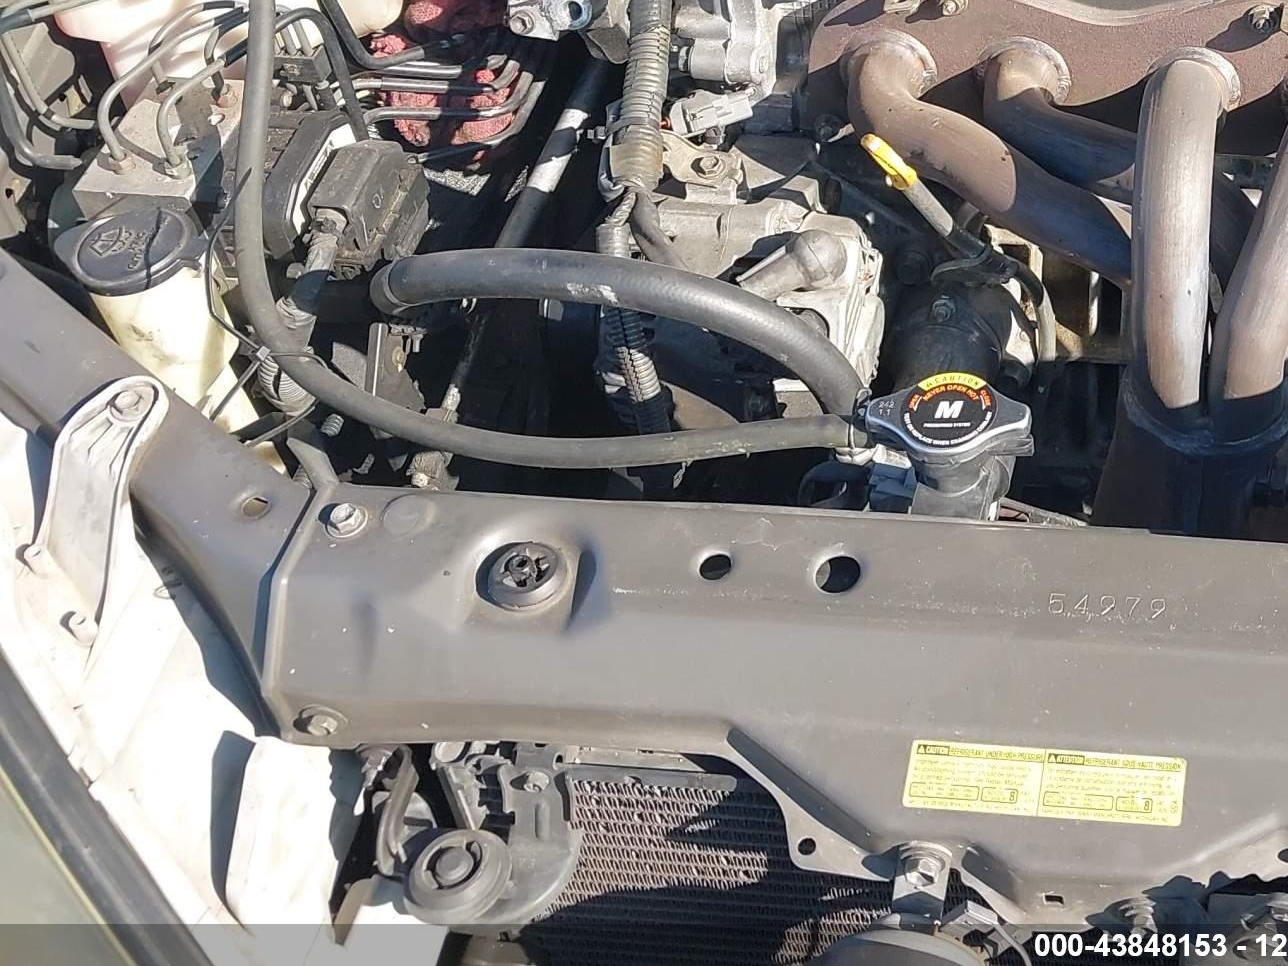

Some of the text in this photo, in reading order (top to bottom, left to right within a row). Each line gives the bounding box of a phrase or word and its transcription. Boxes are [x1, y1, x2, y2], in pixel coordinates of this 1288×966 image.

[933, 376, 979, 386] CAUTION
[923, 384, 979, 401] NEVER OPEN HOT
[878, 400, 895, 409] 242
[934, 400, 965, 419] M
[925, 745, 949, 755] CAUTION
